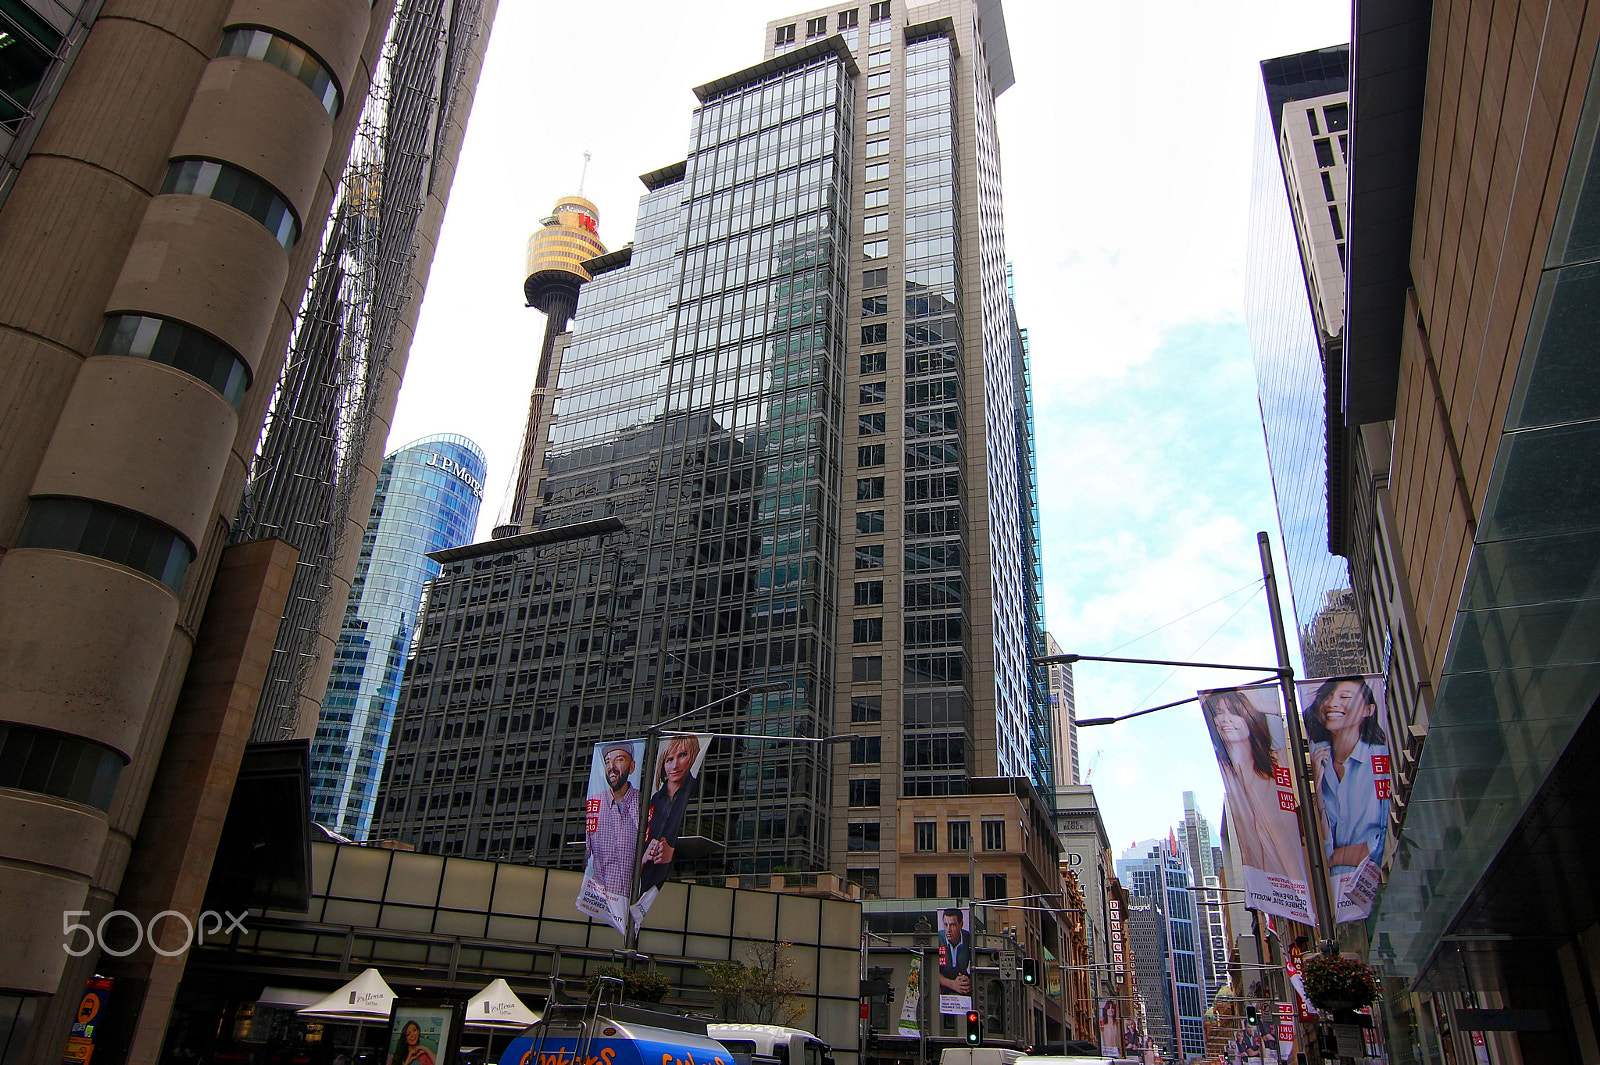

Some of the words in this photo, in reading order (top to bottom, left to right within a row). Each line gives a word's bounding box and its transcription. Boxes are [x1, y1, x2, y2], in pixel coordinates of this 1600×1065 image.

[1128, 903, 1151, 912] Ausgrid
[1110, 901, 1124, 972] DYMOCKS
[1130, 954, 1140, 1009] GOWINGS
